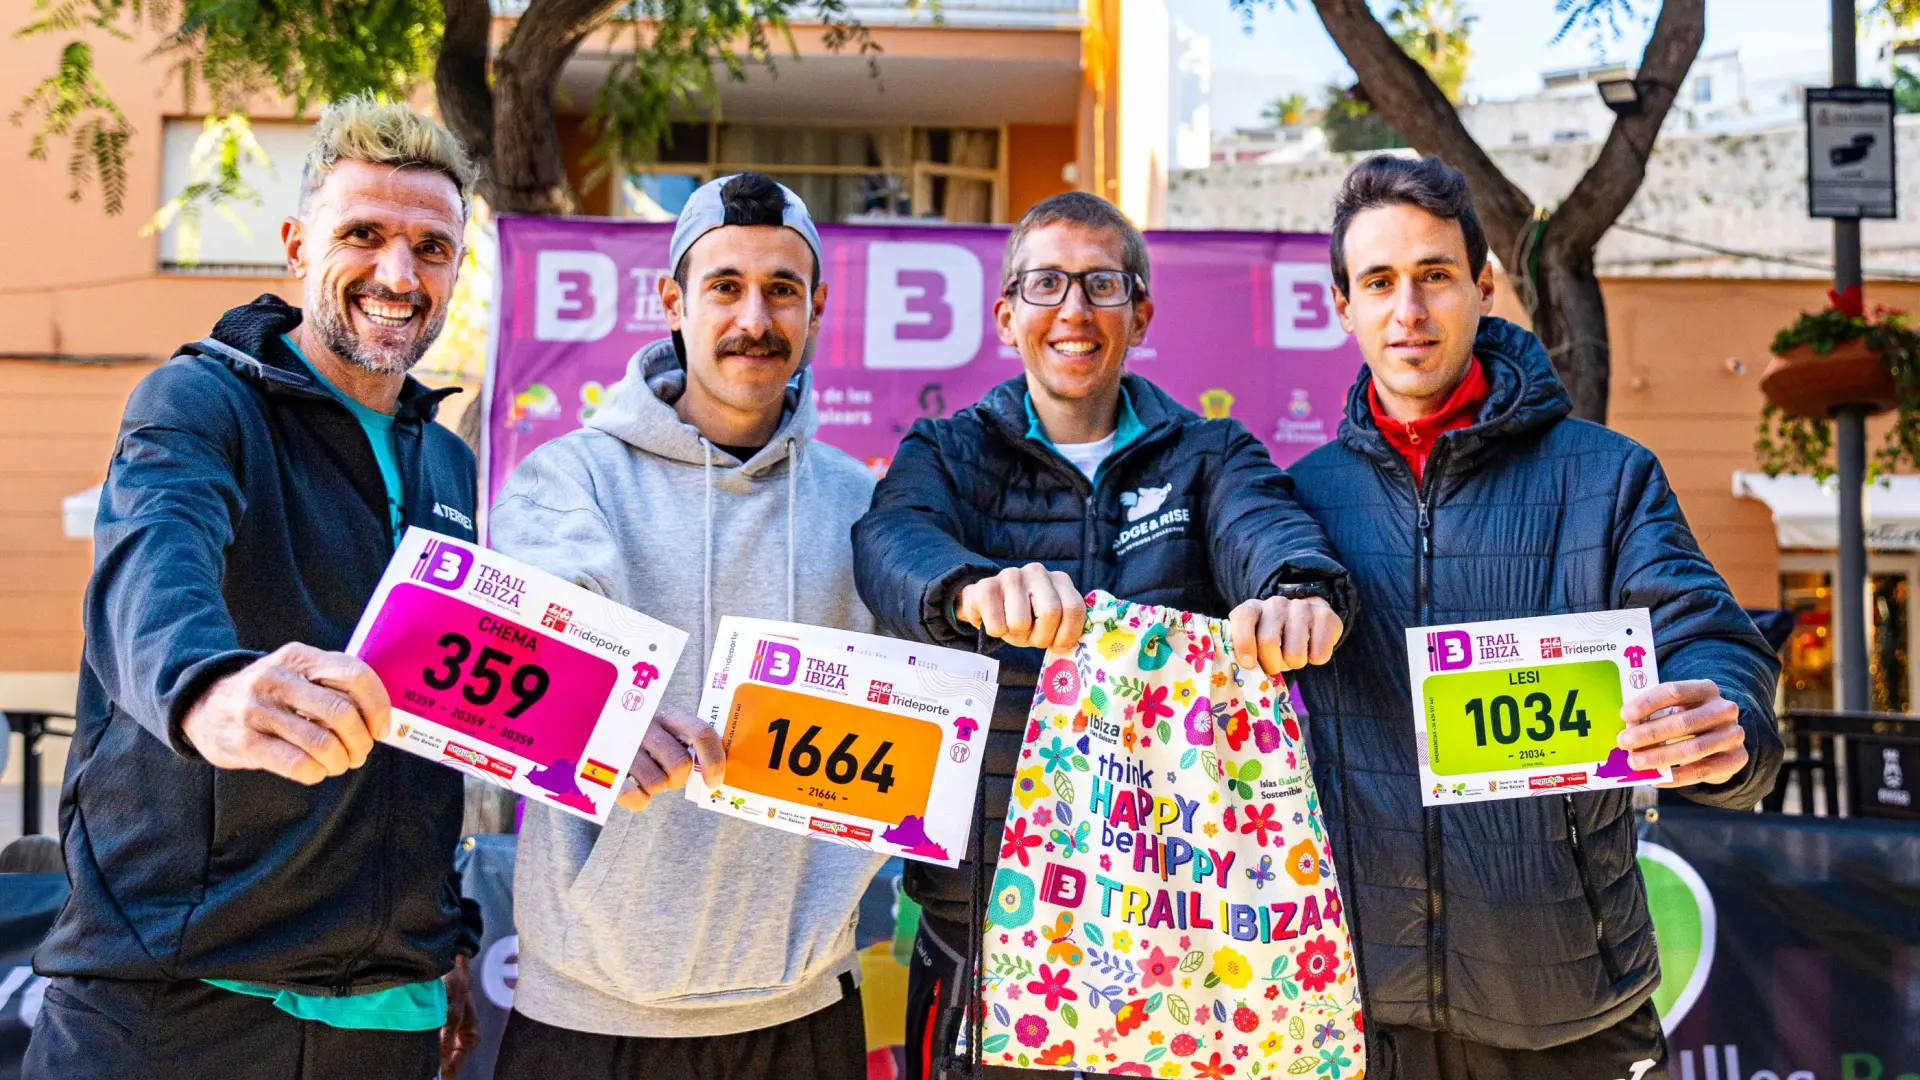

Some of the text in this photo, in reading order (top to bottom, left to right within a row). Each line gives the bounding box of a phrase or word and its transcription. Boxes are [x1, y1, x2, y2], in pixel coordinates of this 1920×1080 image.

[819, 407, 872, 426] alears
[1160, 509, 1190, 526] RISE
[480, 564, 526, 594] TRAIL
[473, 578, 520, 608] IBIZA
[478, 616, 537, 652] CHEMA
[568, 623, 630, 657] Trideporte
[1476, 633, 1519, 647] TRAIL
[1479, 645, 1519, 660] IBIZA
[1563, 642, 1617, 655] Trideporte
[423, 632, 550, 719] 359
[806, 657, 849, 677] TRAIL
[1508, 671, 1540, 686] LESI
[804, 670, 845, 690] IBIZA
[892, 694, 950, 716] Trideporte
[404, 690, 435, 708] 10359
[451, 708, 486, 727] 20359
[501, 727, 534, 746] 30359
[1090, 713, 1120, 737] Ibiza
[1465, 689, 1592, 747] 1034
[768, 718, 895, 794] 1664
[1519, 749, 1545, 760] 21034
[1099, 753, 1154, 788] think
[808, 787, 836, 801] 21664
[1260, 780, 1277, 788] Islas
[1089, 775, 1200, 835] HAPPY
[1095, 874, 1323, 944] TRAIL IBIZA
